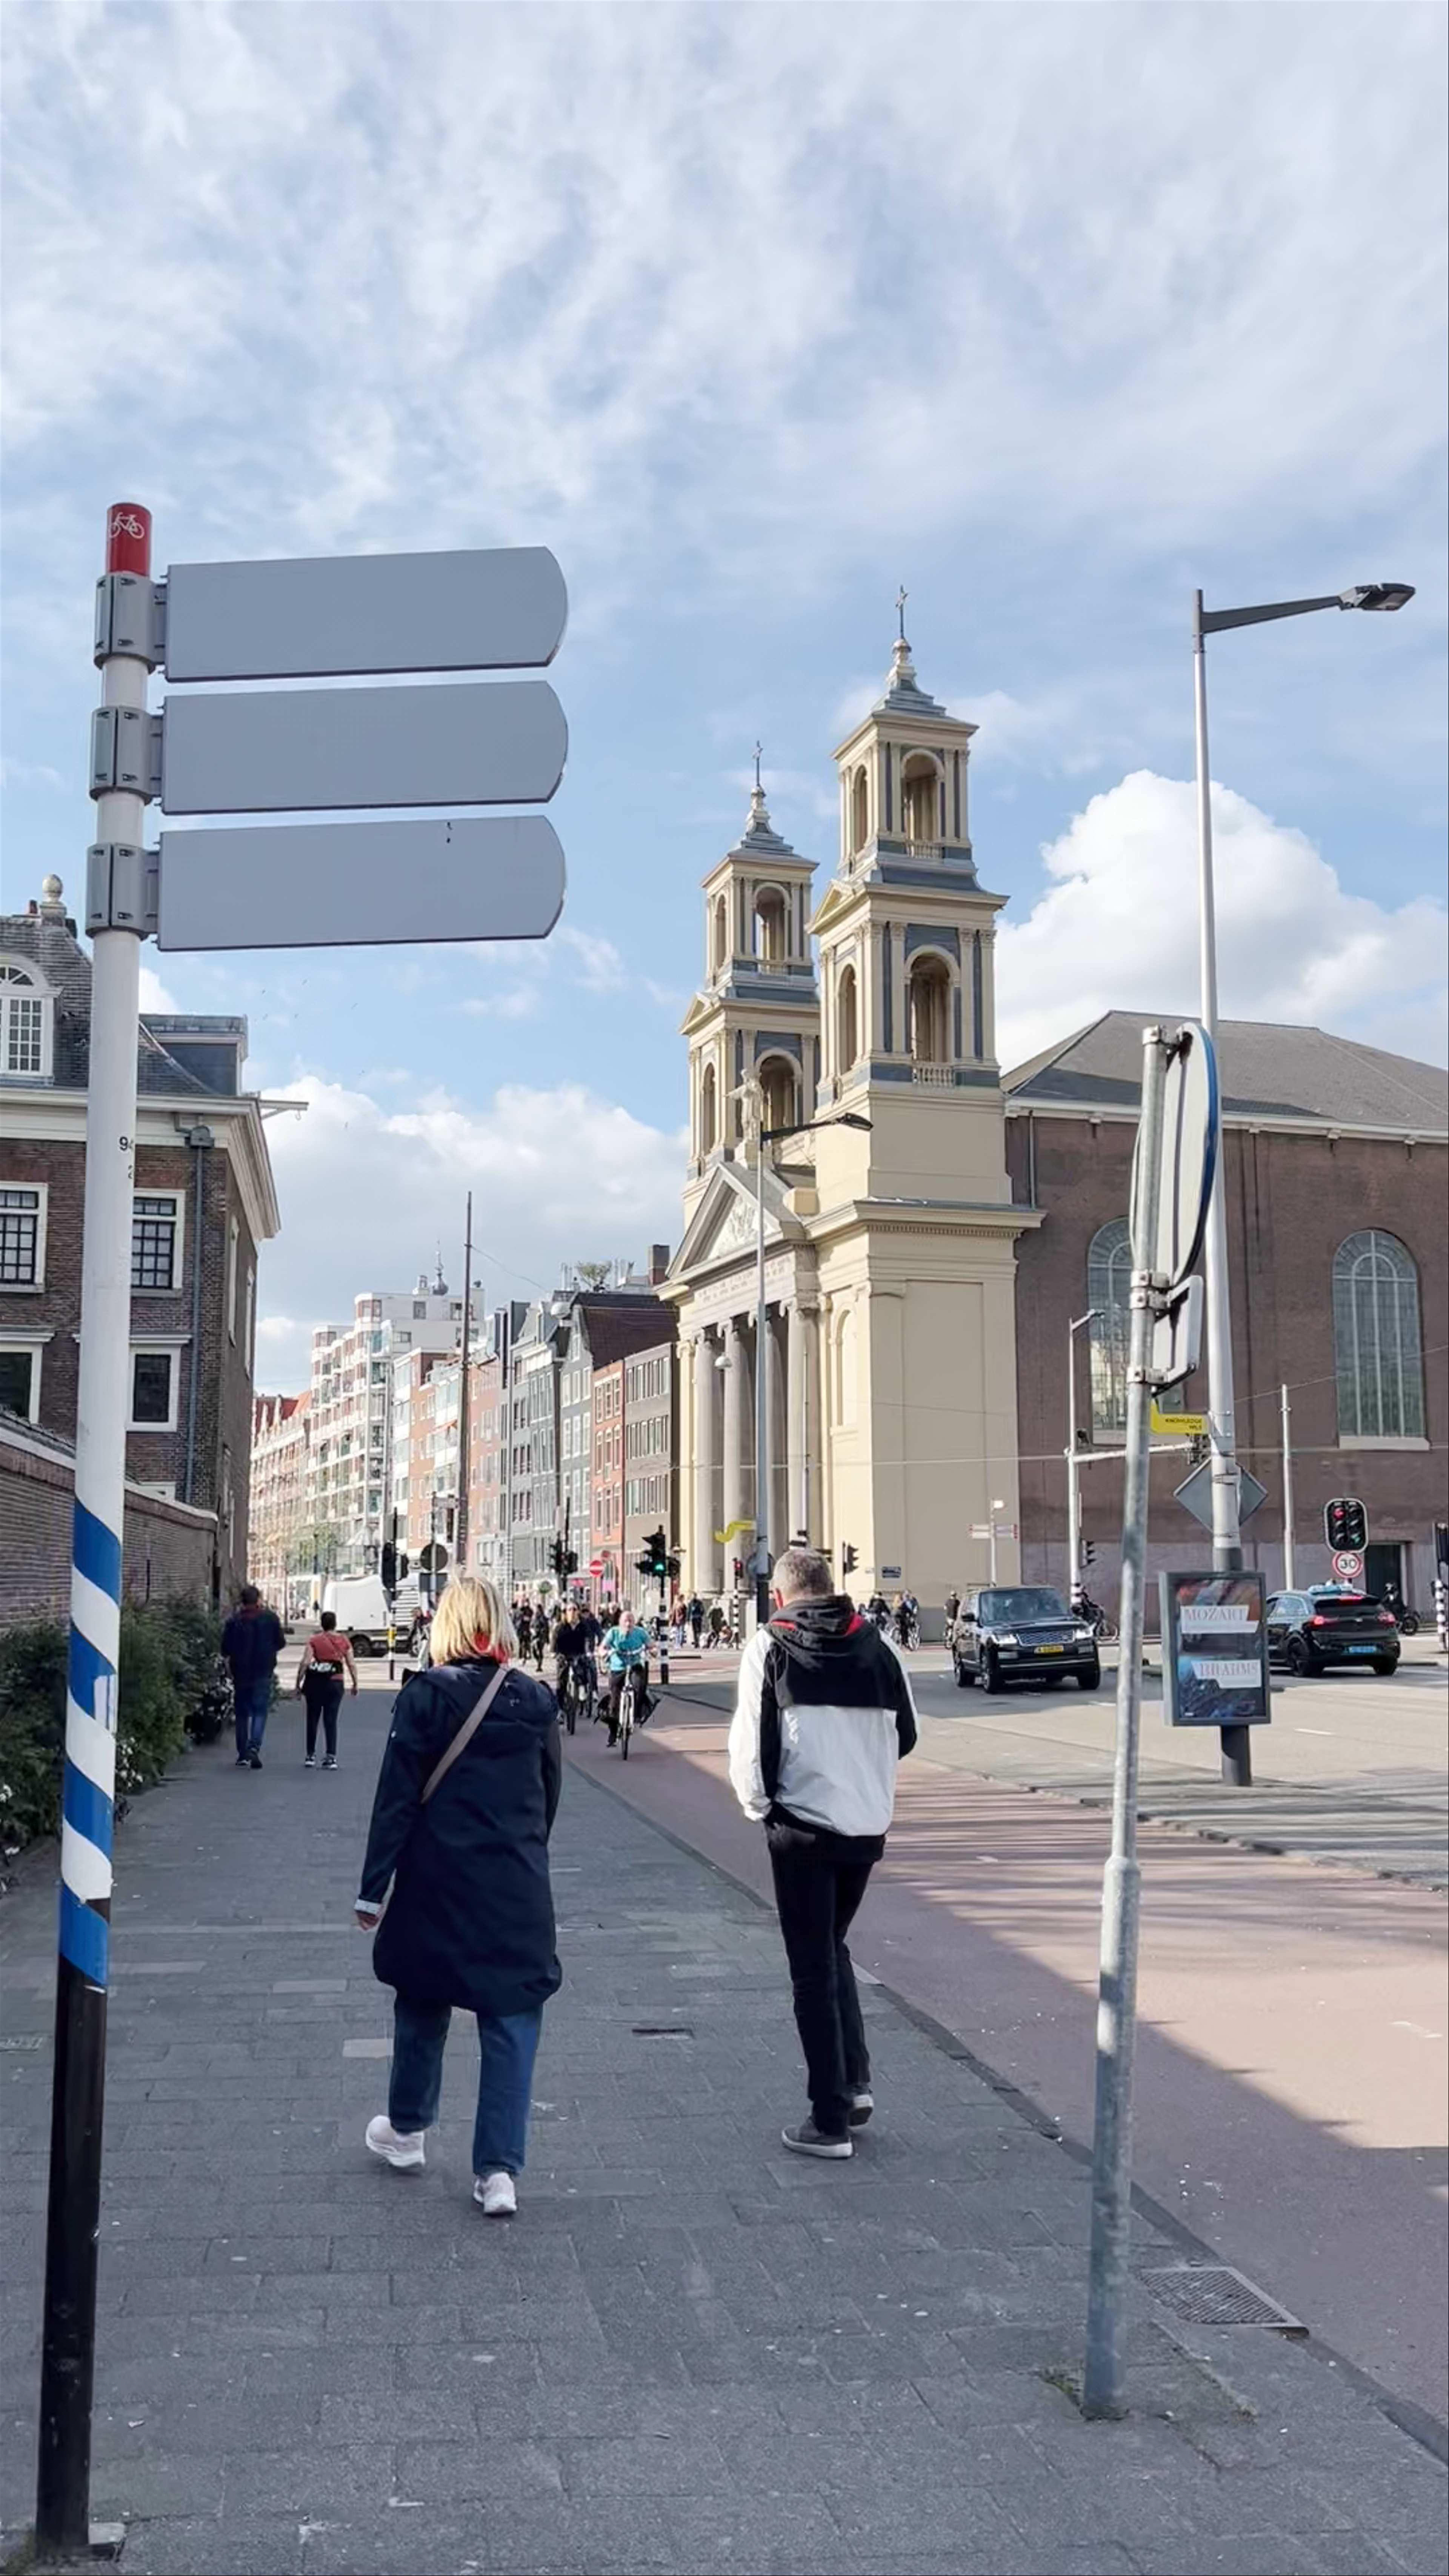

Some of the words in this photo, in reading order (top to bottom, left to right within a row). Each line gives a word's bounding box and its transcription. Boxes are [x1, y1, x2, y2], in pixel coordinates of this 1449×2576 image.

[1340, 1558, 1357, 1569] 30
[1185, 1609, 1246, 1621] MOZART
[1200, 1662, 1258, 1676] BRAHMS
